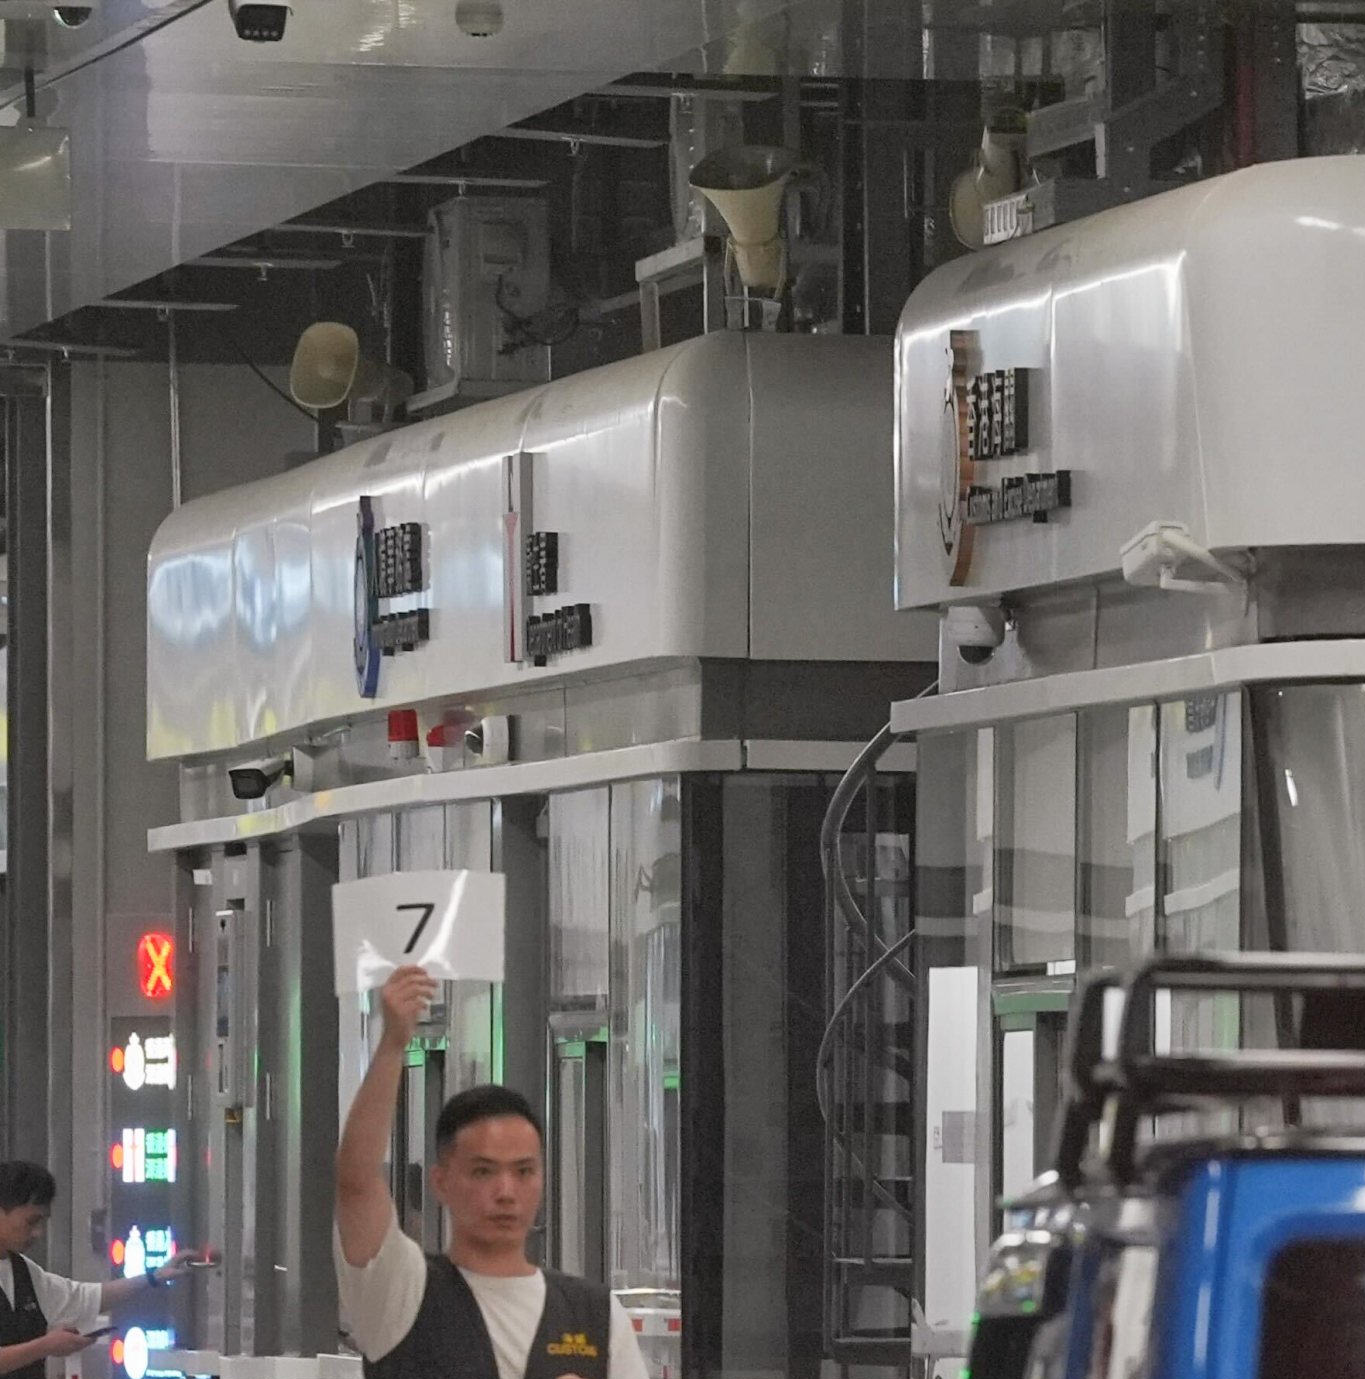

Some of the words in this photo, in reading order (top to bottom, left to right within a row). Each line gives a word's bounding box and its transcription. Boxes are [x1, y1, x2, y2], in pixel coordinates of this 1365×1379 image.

[966, 368, 1024, 460] 香港海關
[396, 903, 435, 954] 7
